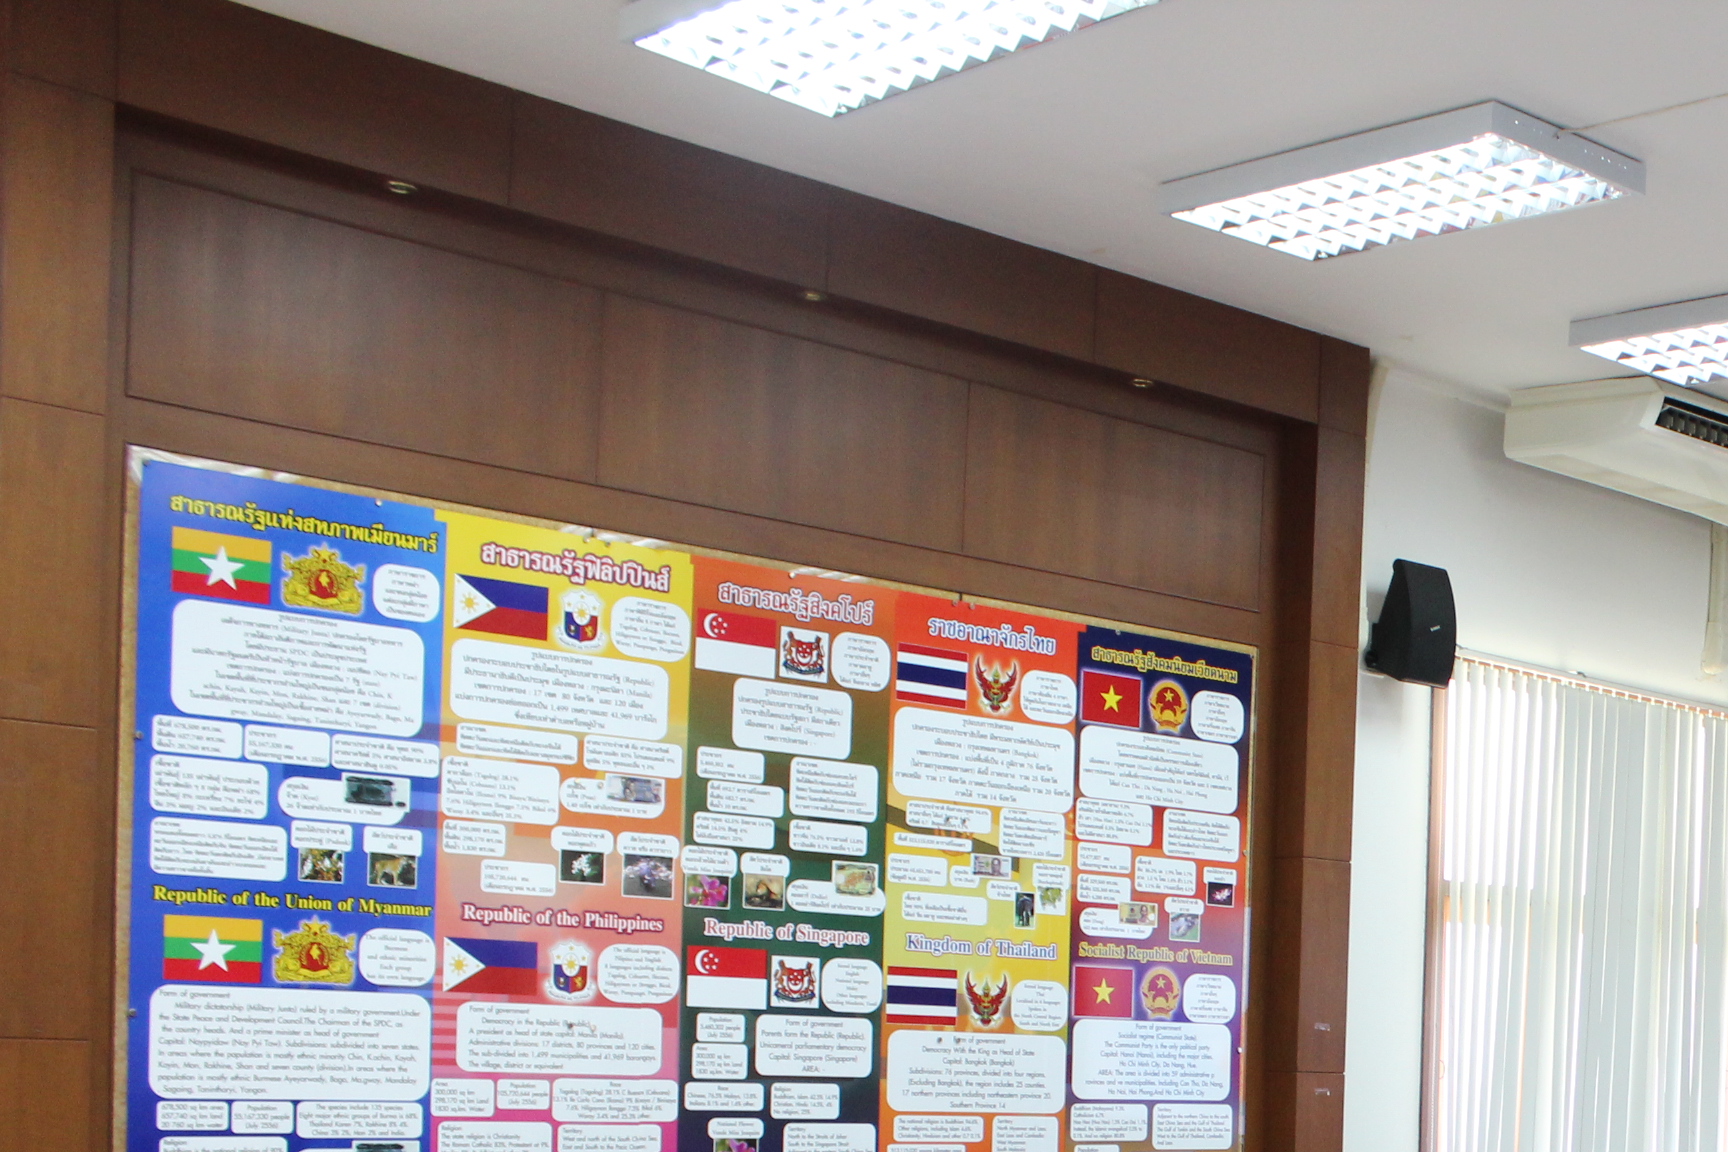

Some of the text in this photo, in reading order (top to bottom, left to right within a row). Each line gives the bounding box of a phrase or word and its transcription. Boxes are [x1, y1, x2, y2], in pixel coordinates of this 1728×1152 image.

[481, 542, 671, 592] สาธารณรัฐฟิลิปปินส์
[718, 581, 875, 626] สาธารณรัฐสิงคโปร์
[928, 617, 1057, 655] ราชอาณาจักรไทย
[153, 885, 433, 917] Republic of the Union of Myanmar
[462, 902, 664, 935] Republic of the Philippines
[704, 917, 870, 948] Republic of Singapore
[906, 933, 1058, 960] Kingdom of Thailand
[1079, 942, 1234, 966] Socialist Republic of Vietnam
